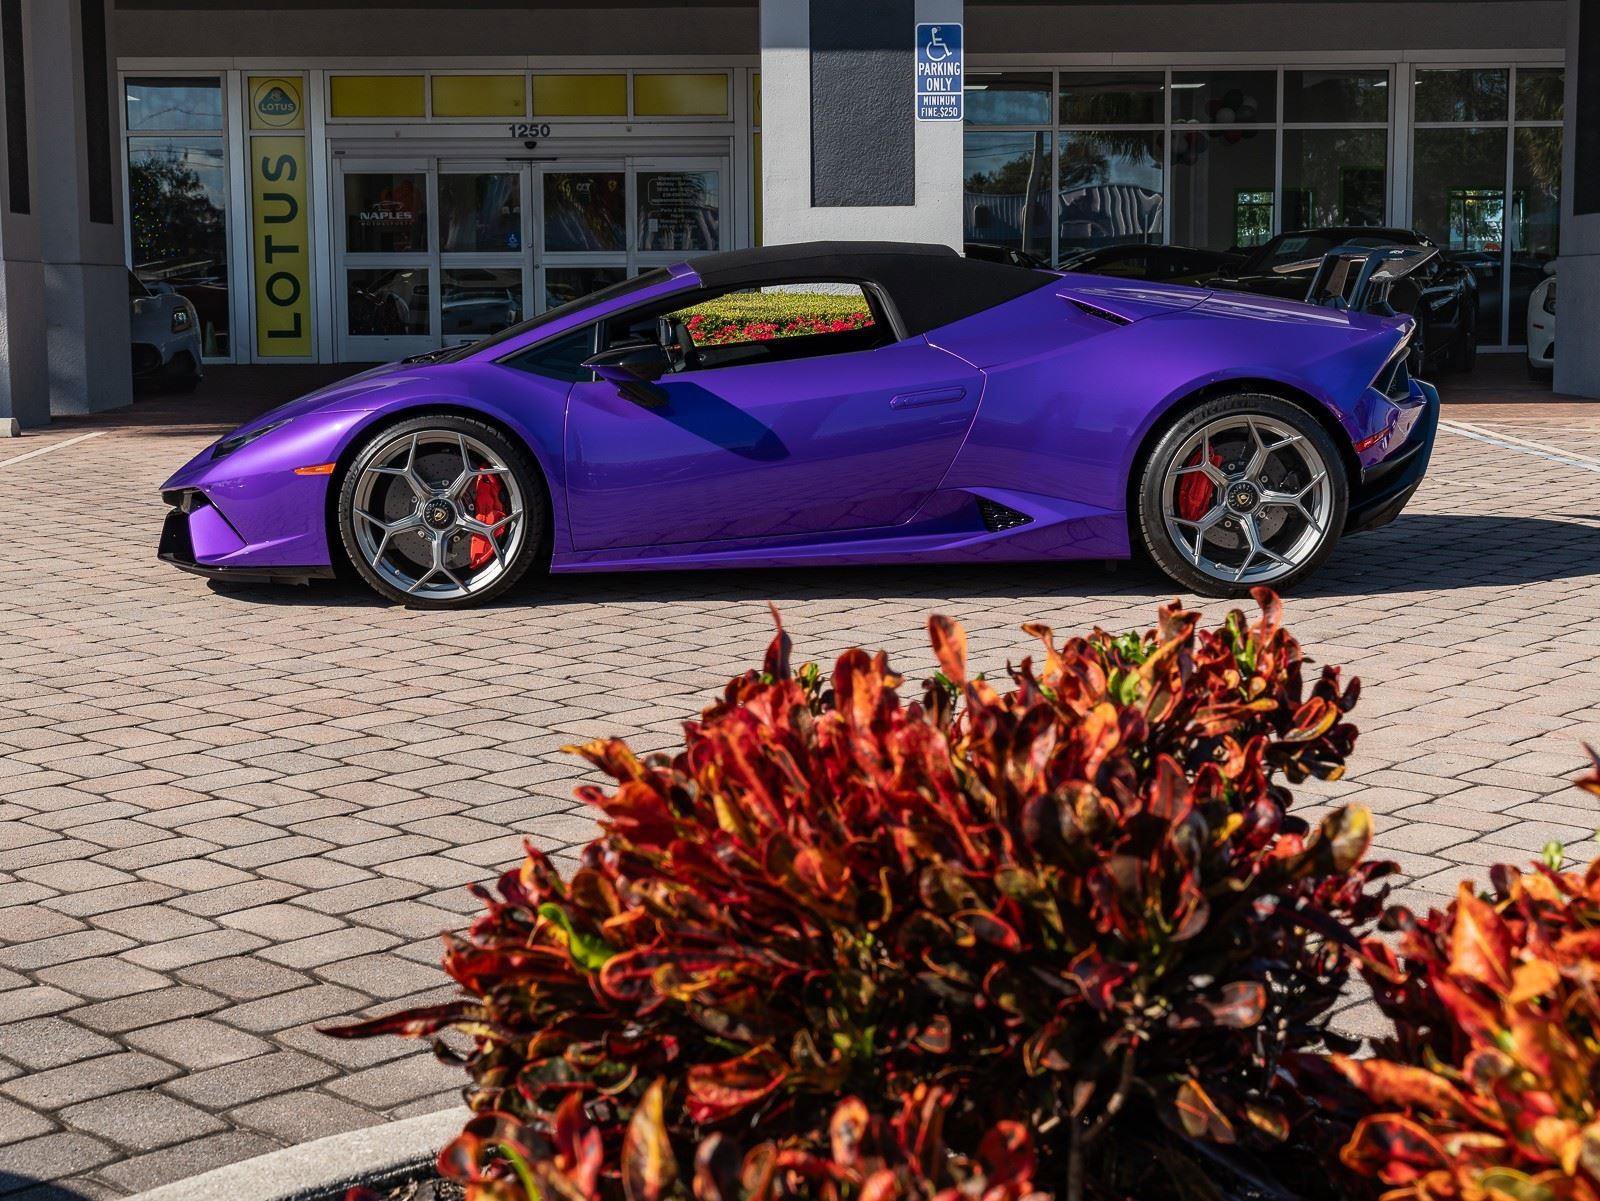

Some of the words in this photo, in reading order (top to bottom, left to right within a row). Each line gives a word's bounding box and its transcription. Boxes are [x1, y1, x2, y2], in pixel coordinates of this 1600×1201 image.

[918, 62, 961, 76] PARKING
[926, 78, 952, 91] ONLY
[923, 96, 956, 105] MINIMUM
[261, 103, 294, 111] LOTUS
[921, 107, 937, 117] FINE
[940, 107, 958, 117] $250
[508, 123, 551, 138] 1250
[360, 212, 412, 220] NAPLES
[261, 153, 302, 338] LOTUS
